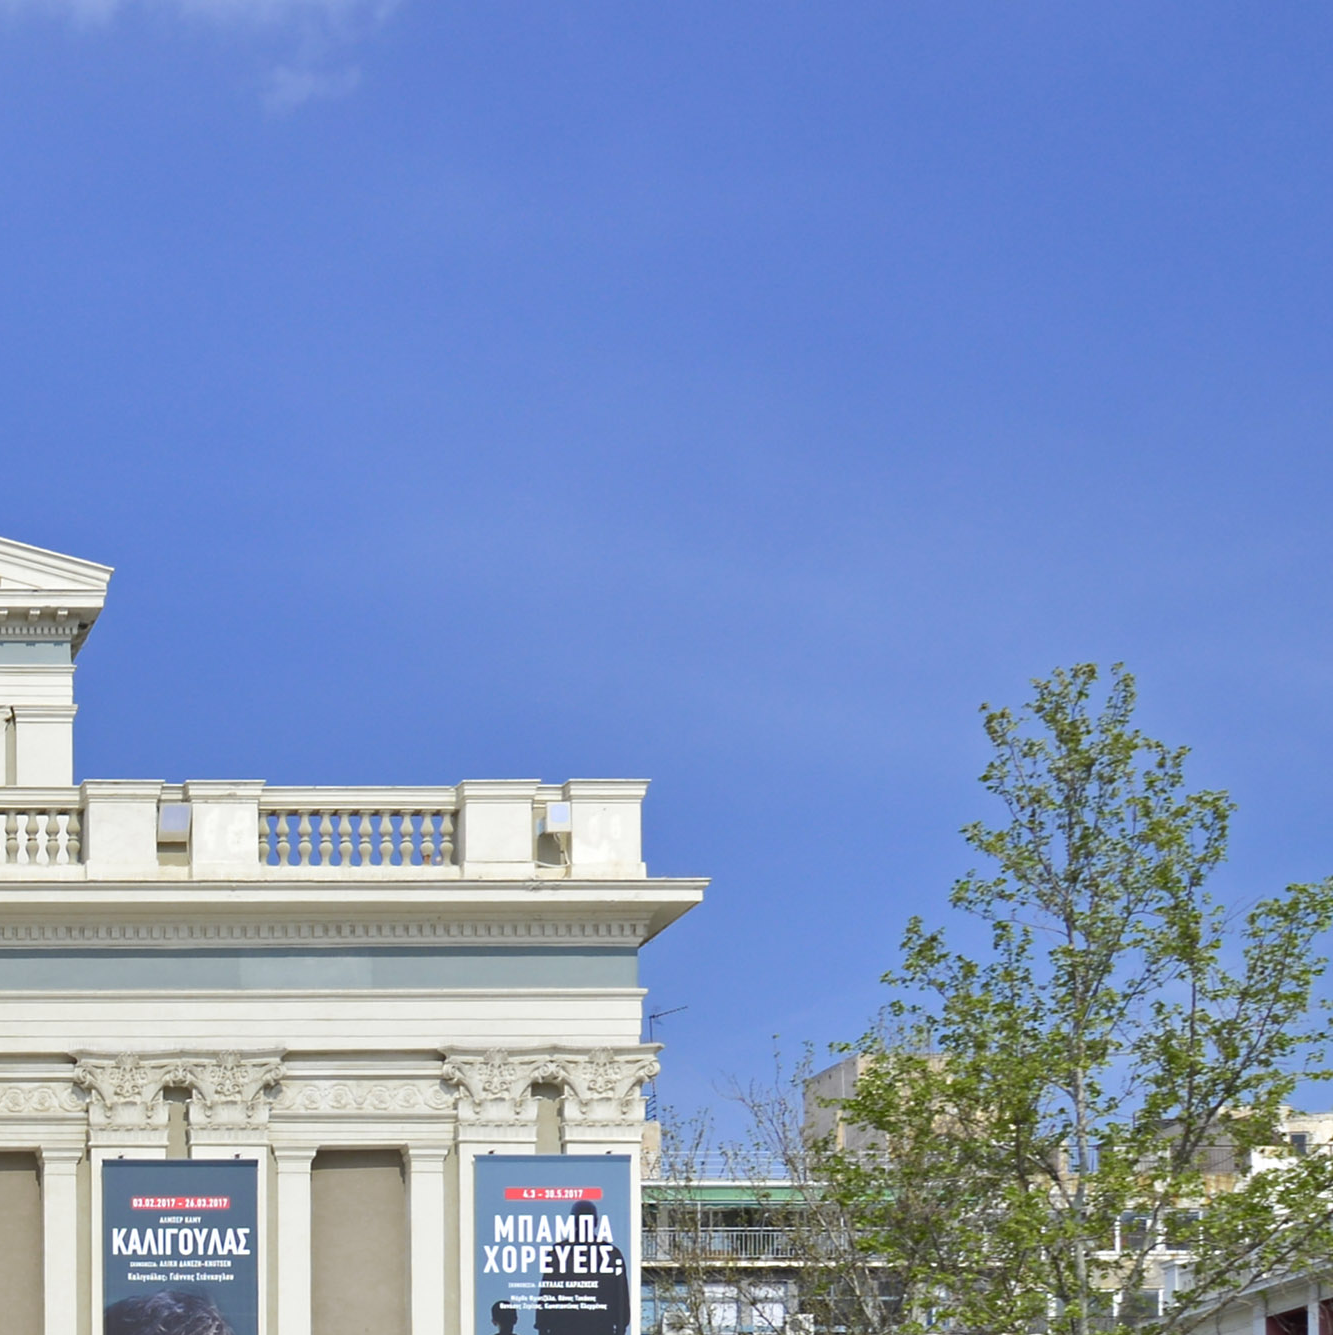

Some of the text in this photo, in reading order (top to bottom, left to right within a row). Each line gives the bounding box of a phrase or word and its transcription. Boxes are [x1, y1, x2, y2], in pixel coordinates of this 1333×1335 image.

[133, 1198, 175, 1207] 03.02.2017
[185, 1198, 228, 1207] 26.03.2017
[112, 1228, 251, 1255] ΚΑΛΙΓΟΥΛΑΣ
[494, 1215, 613, 1242] ΜΠΑΜΠΑ
[483, 1245, 623, 1276] ΧΟΡΕΥΕΙΣ;
